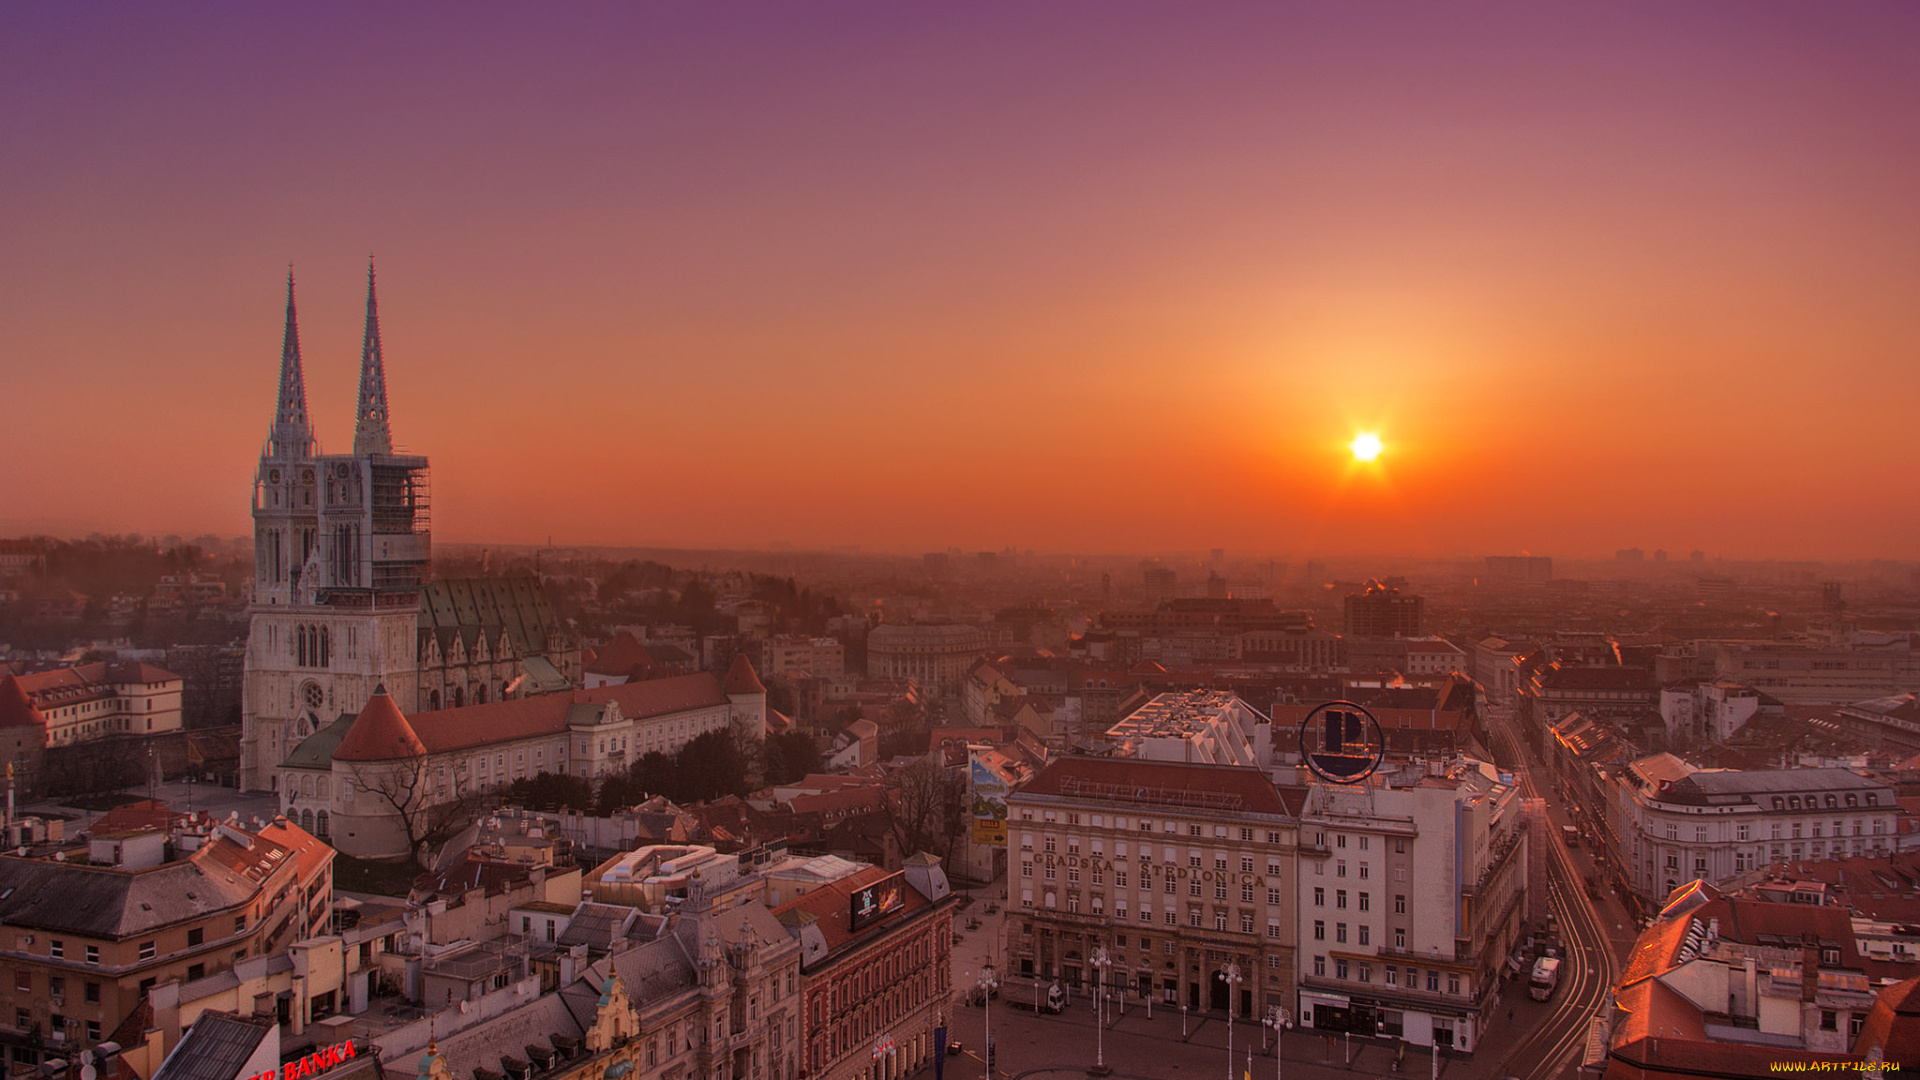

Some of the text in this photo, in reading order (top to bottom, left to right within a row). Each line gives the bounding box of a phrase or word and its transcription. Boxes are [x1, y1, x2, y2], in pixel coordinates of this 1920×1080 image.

[1033, 853, 1266, 887] GRADSKA ŠTEDIONICA
[284, 1039, 356, 1080] BANKA
